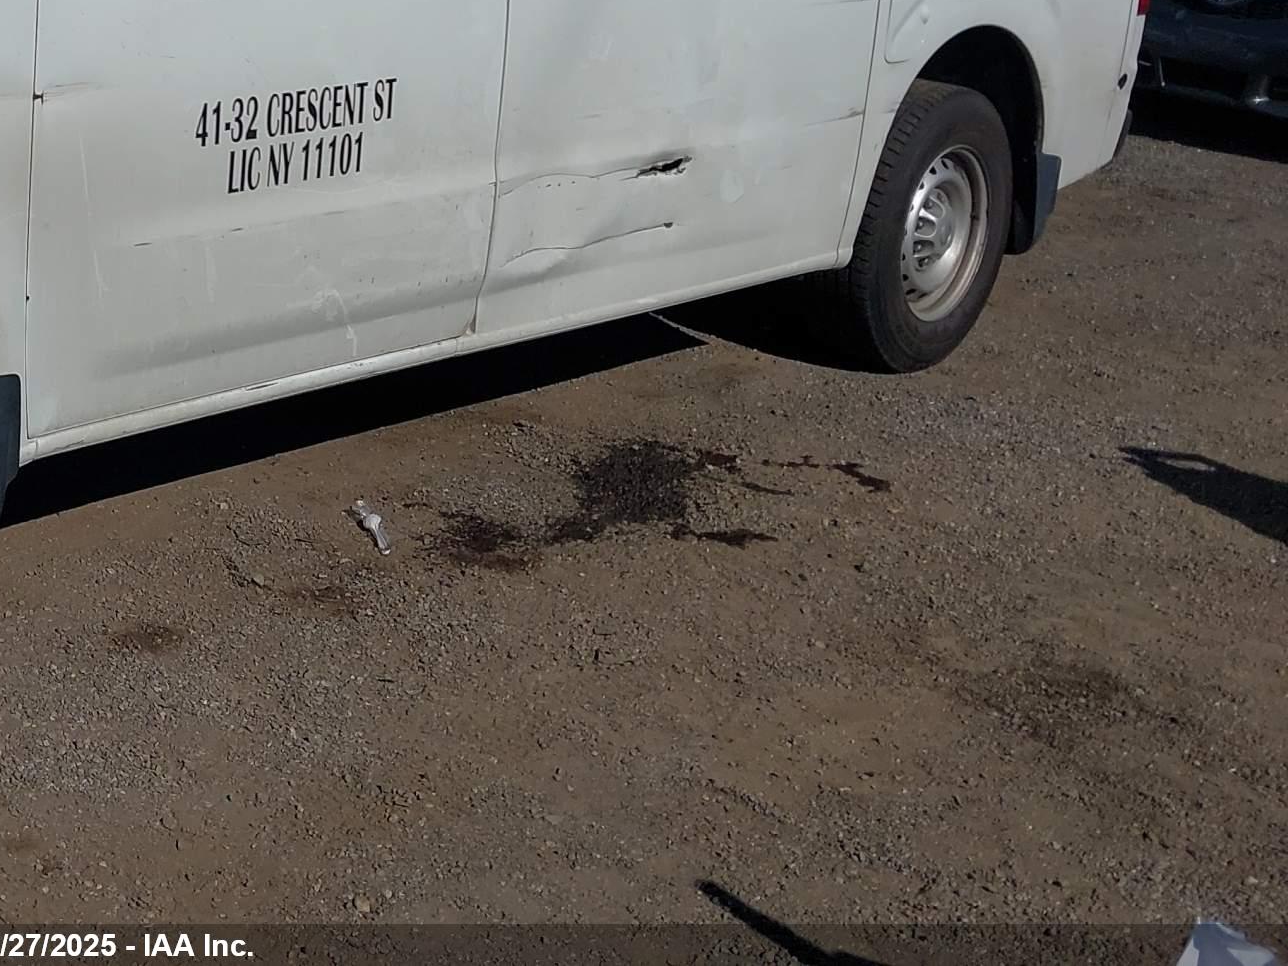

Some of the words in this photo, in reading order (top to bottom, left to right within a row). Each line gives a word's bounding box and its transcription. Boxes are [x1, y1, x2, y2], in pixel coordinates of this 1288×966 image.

[195, 96, 259, 147] 41-32
[267, 81, 369, 137] CRESCENT
[373, 78, 397, 122] ST
[227, 146, 261, 194] LIC
[267, 141, 295, 187] NY
[301, 132, 364, 181] 11101
